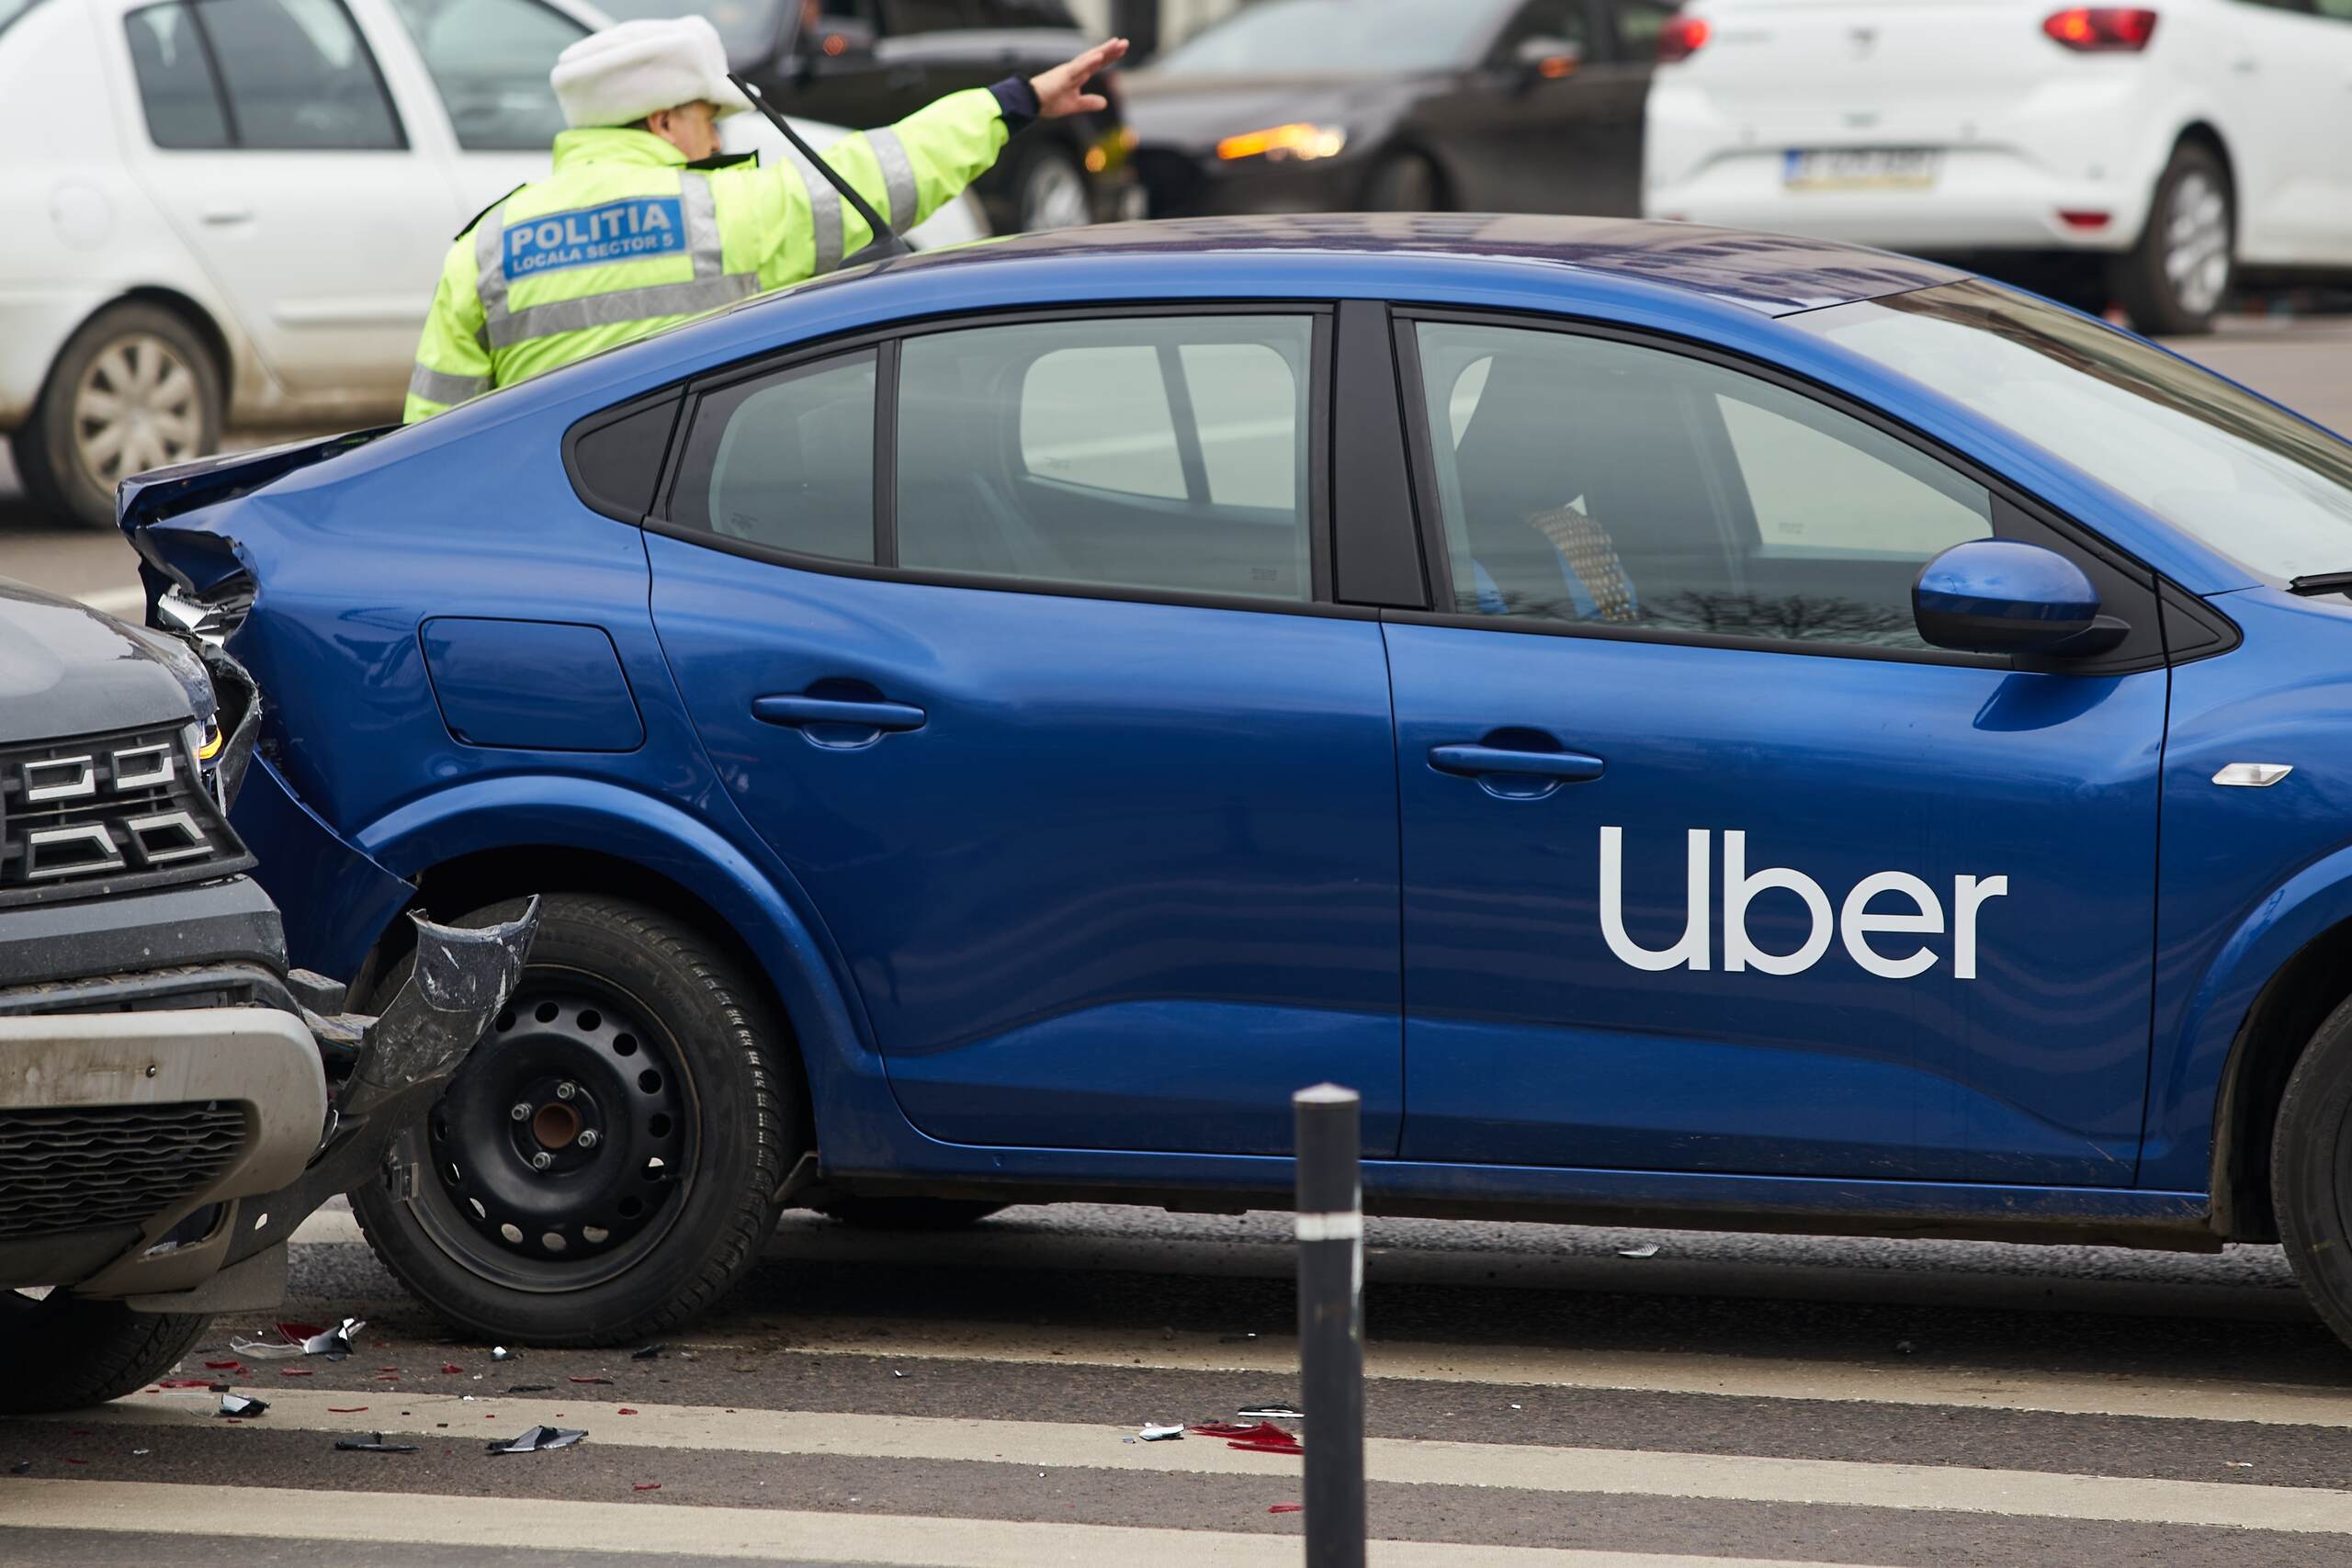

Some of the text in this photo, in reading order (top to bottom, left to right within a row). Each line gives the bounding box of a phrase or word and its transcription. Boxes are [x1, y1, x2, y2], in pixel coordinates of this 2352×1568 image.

[512, 203, 672, 256] POLITIA
[513, 232, 674, 273] LOCALA SECTOR 5
[1600, 826, 2008, 979] Uber
